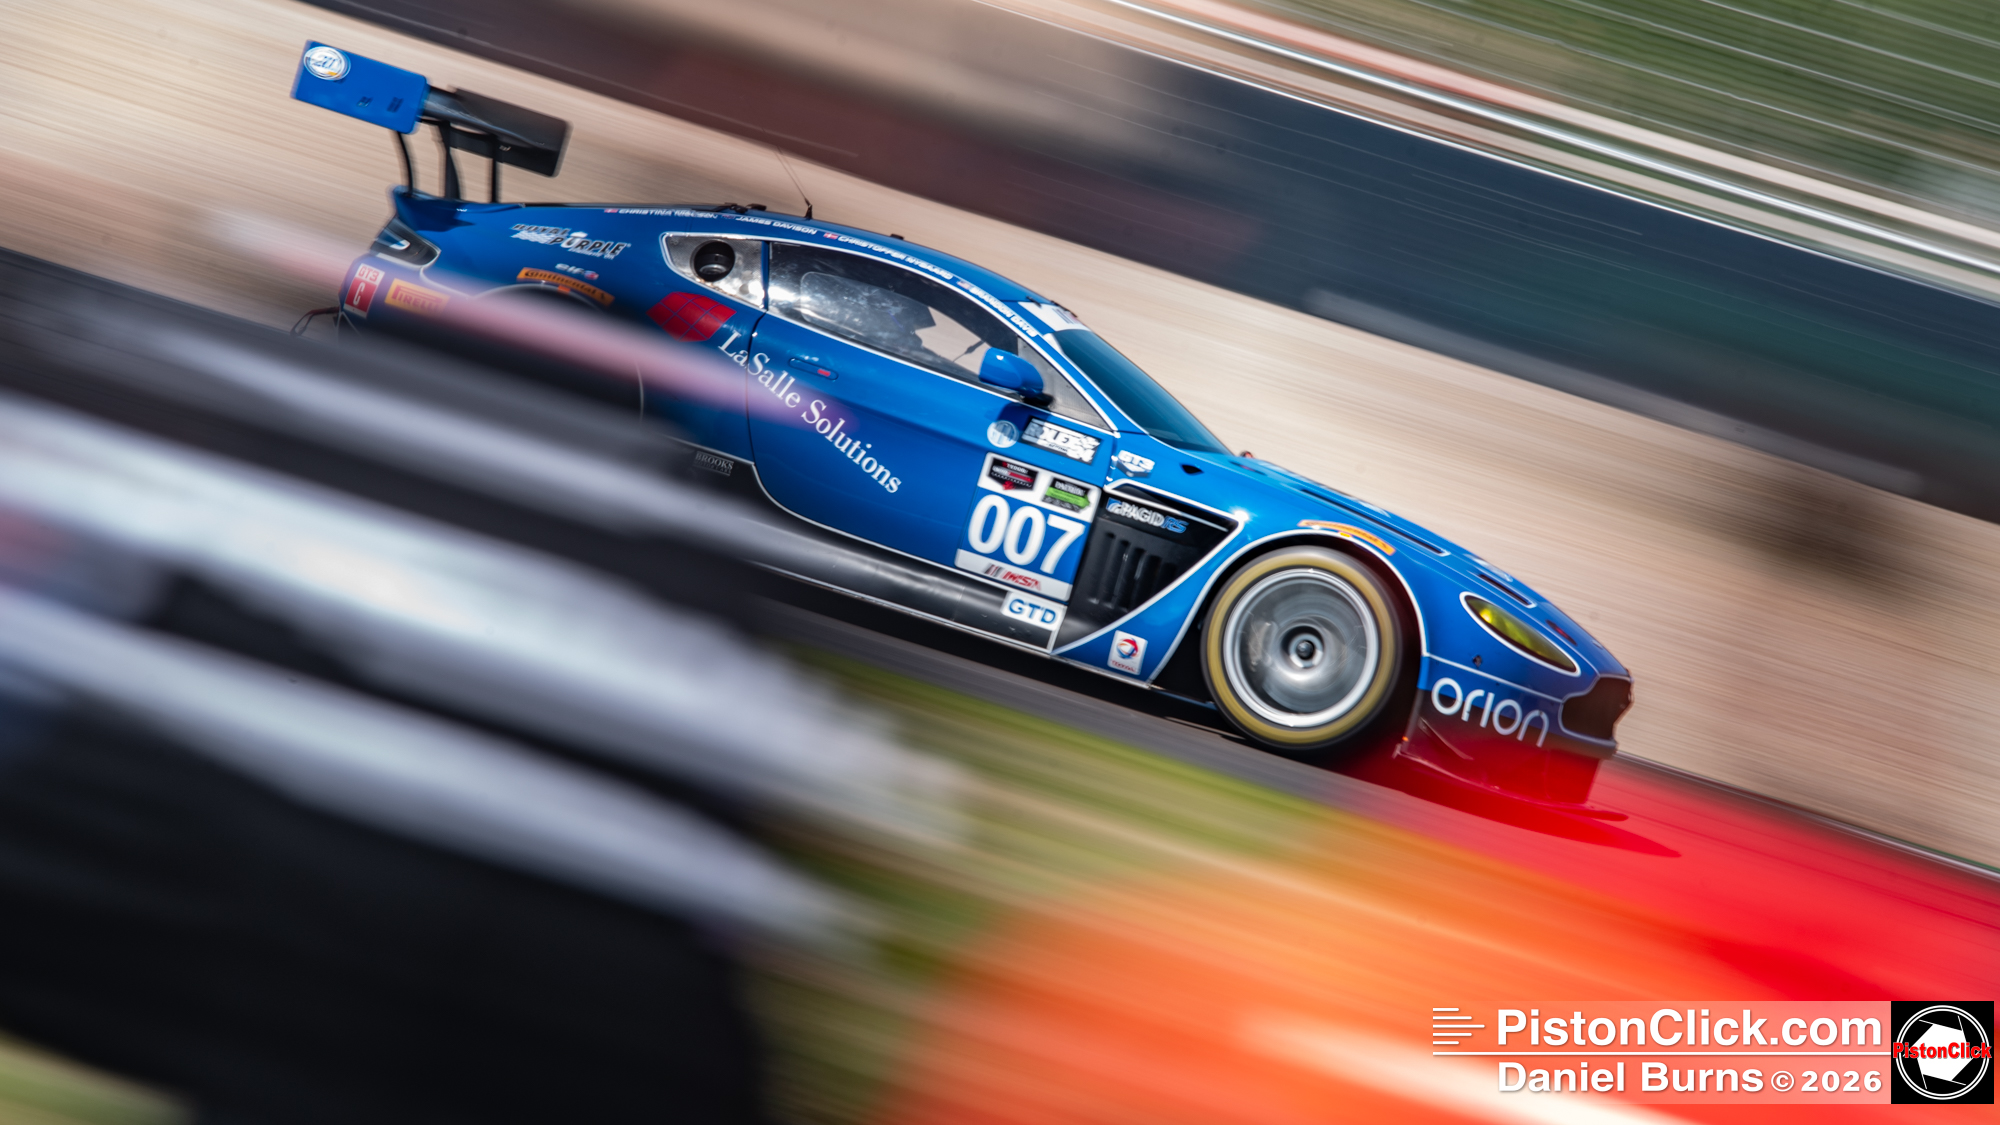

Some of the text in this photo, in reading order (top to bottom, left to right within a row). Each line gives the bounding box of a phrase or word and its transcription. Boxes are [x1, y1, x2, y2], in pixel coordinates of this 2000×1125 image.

[509, 223, 571, 236] ROYAL
[735, 216, 818, 235] JAMES DAVISON
[549, 231, 627, 257] PURPLE
[358, 265, 380, 283] GT3
[391, 284, 443, 312] PIRELLI
[718, 329, 902, 494] LaSalle Solutions
[695, 453, 733, 470] BROOKS
[968, 494, 1086, 575] 007
[1009, 598, 1056, 624] GTD
